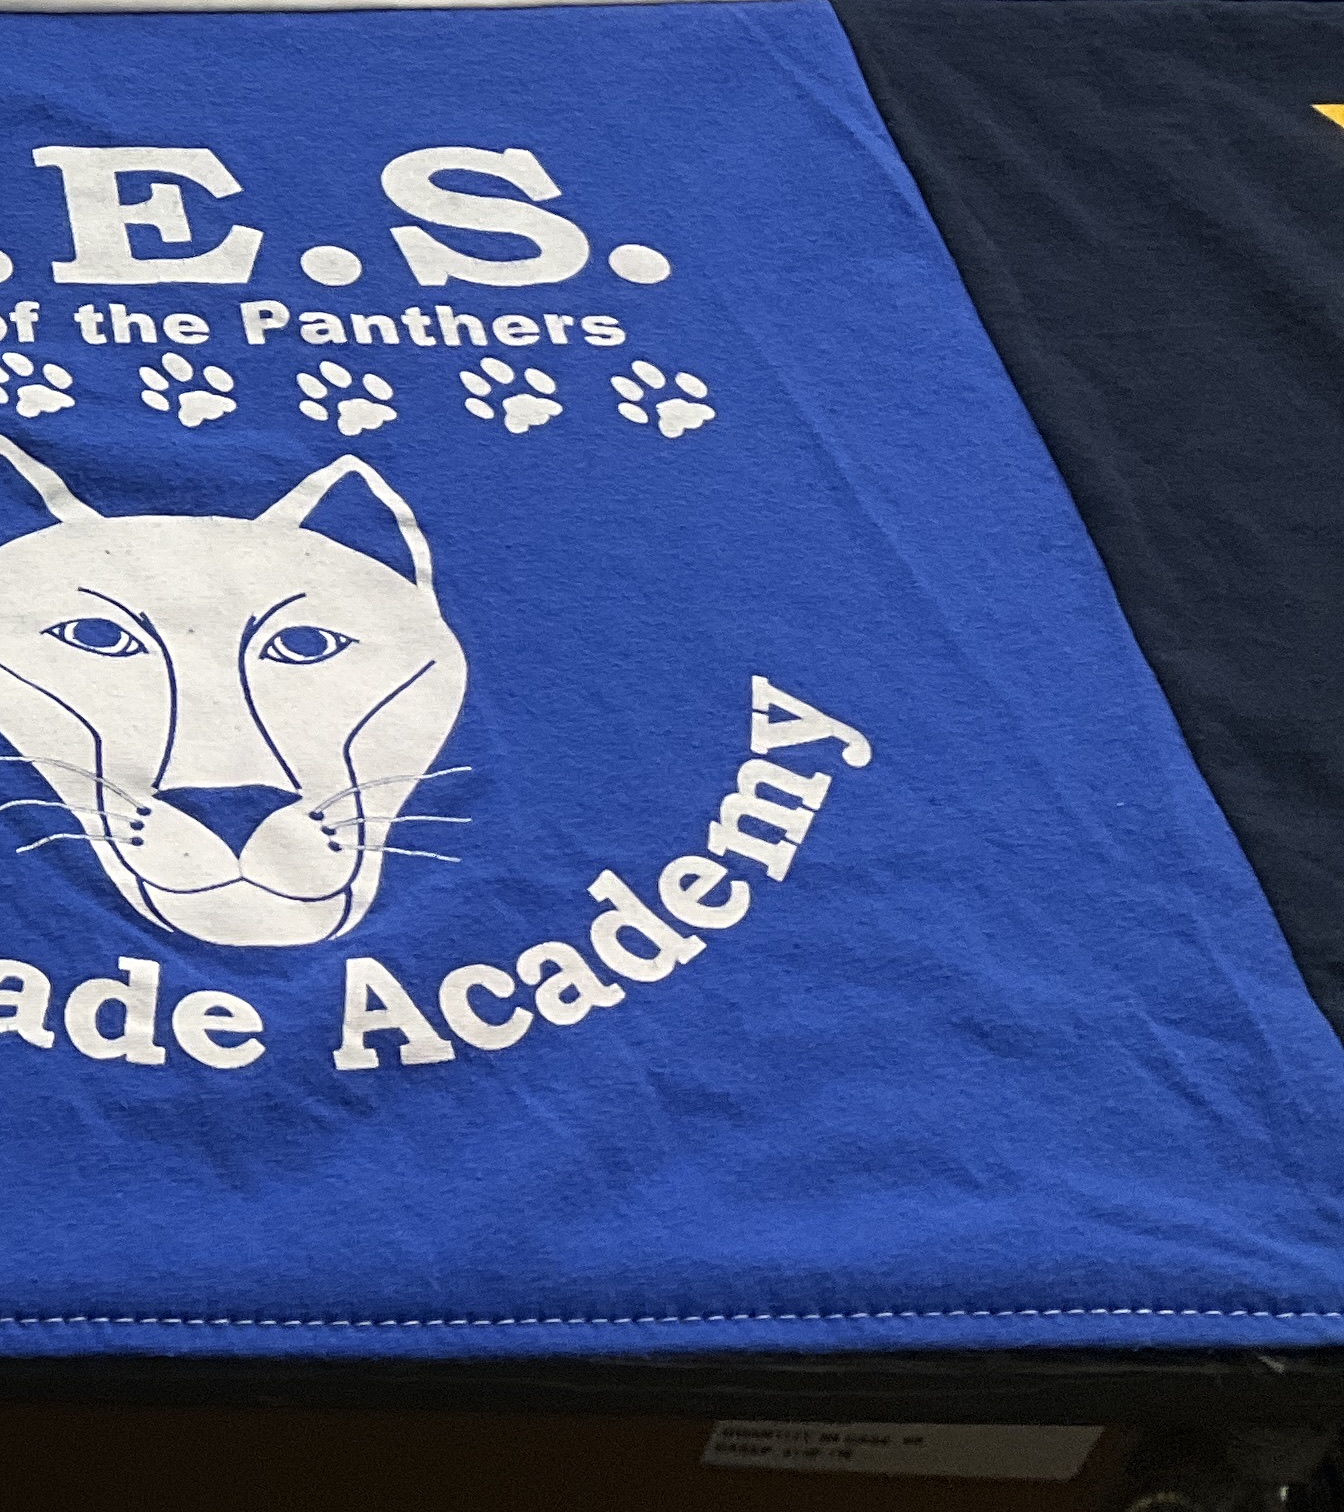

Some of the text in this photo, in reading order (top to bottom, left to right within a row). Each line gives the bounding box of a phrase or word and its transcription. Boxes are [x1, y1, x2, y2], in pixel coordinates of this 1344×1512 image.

[73, 302, 211, 346] the
[242, 299, 628, 348] Panthers
[330, 674, 874, 1071] Academy
